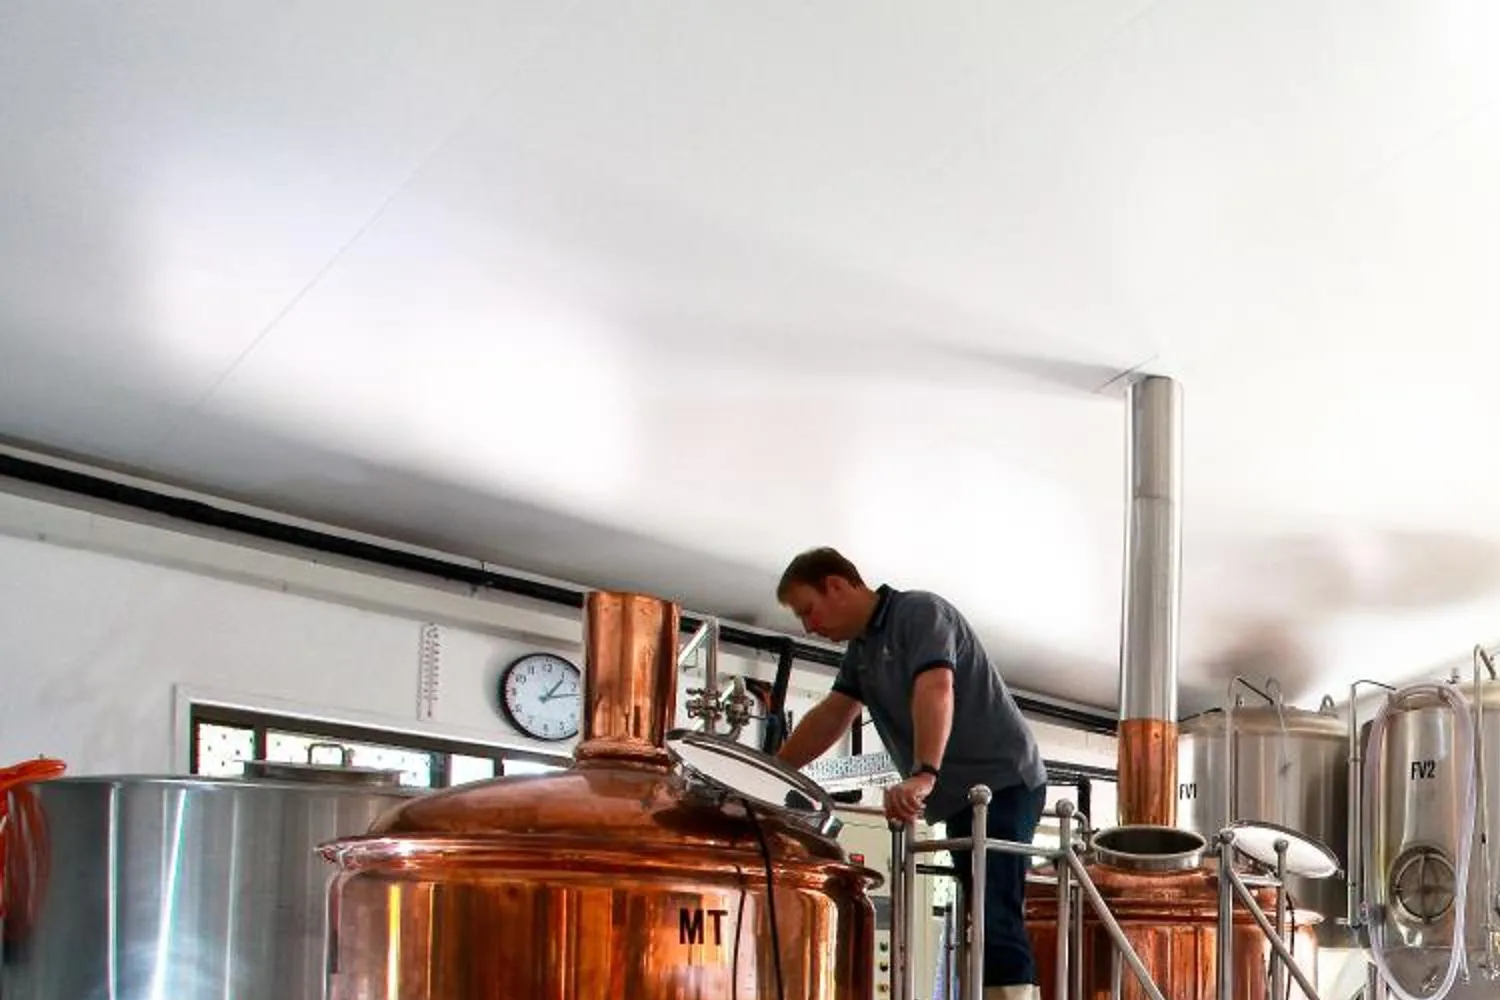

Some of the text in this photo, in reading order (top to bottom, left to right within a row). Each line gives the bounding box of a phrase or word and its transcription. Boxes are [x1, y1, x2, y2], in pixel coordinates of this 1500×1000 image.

[1411, 760, 1436, 780] FV2
[1180, 783, 1197, 800] FV1
[679, 908, 728, 946] MT
